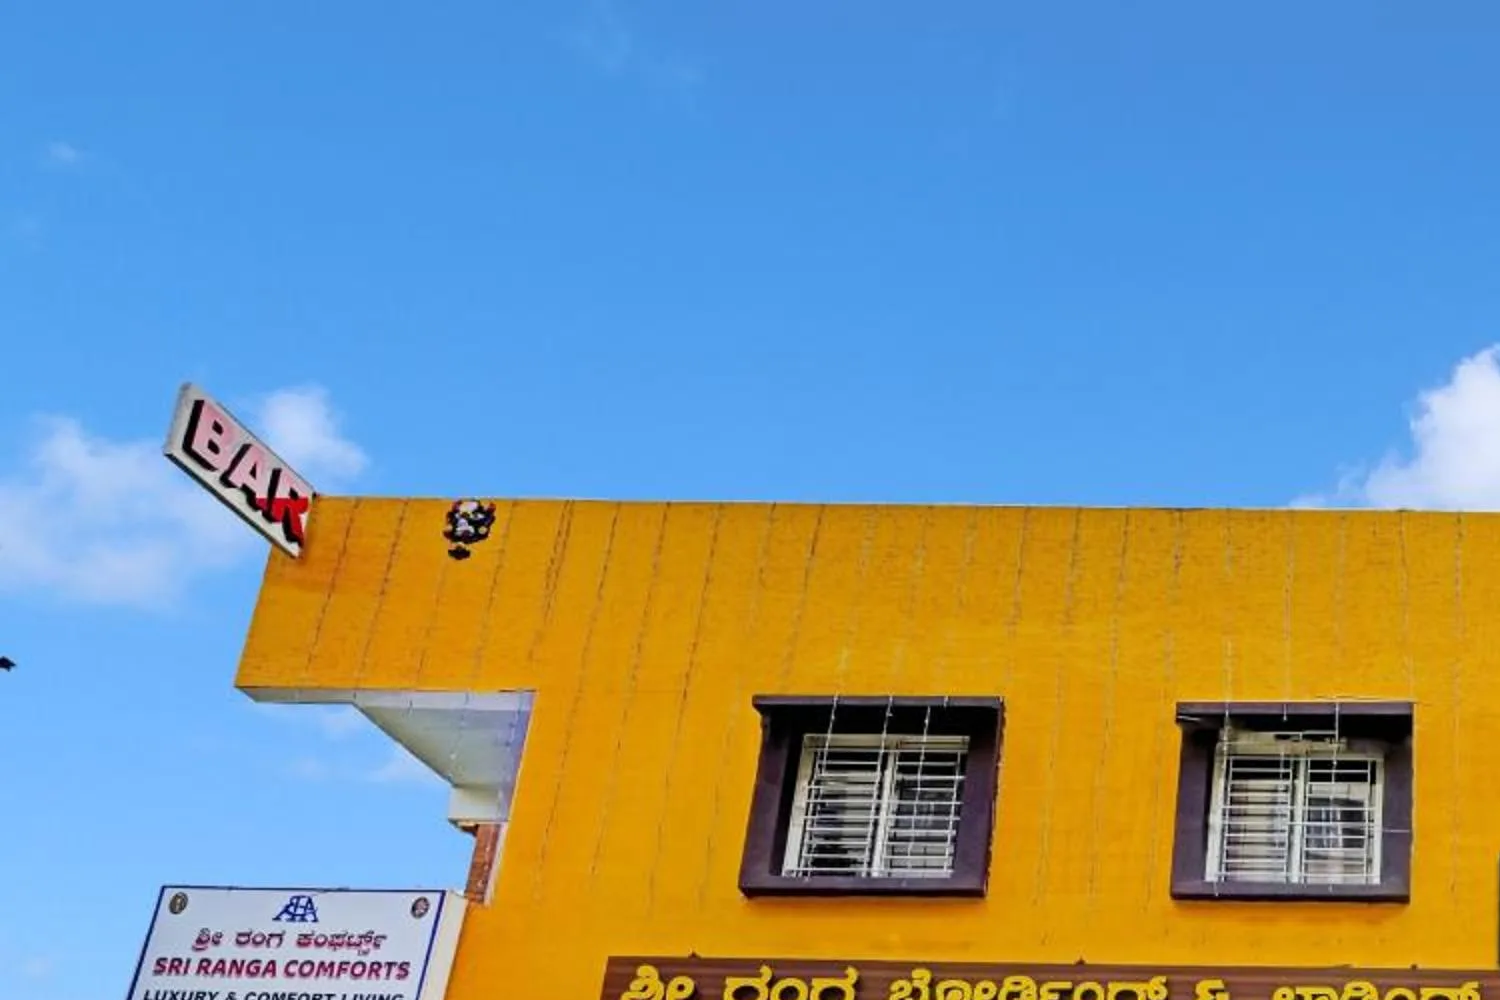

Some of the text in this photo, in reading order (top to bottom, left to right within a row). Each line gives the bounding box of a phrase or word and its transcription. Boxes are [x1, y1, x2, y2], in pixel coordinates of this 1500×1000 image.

[182, 399, 311, 549] BAR
[235, 929, 286, 948] ರಂಗ
[152, 957, 411, 980] SRI RANGA COMFORTS
